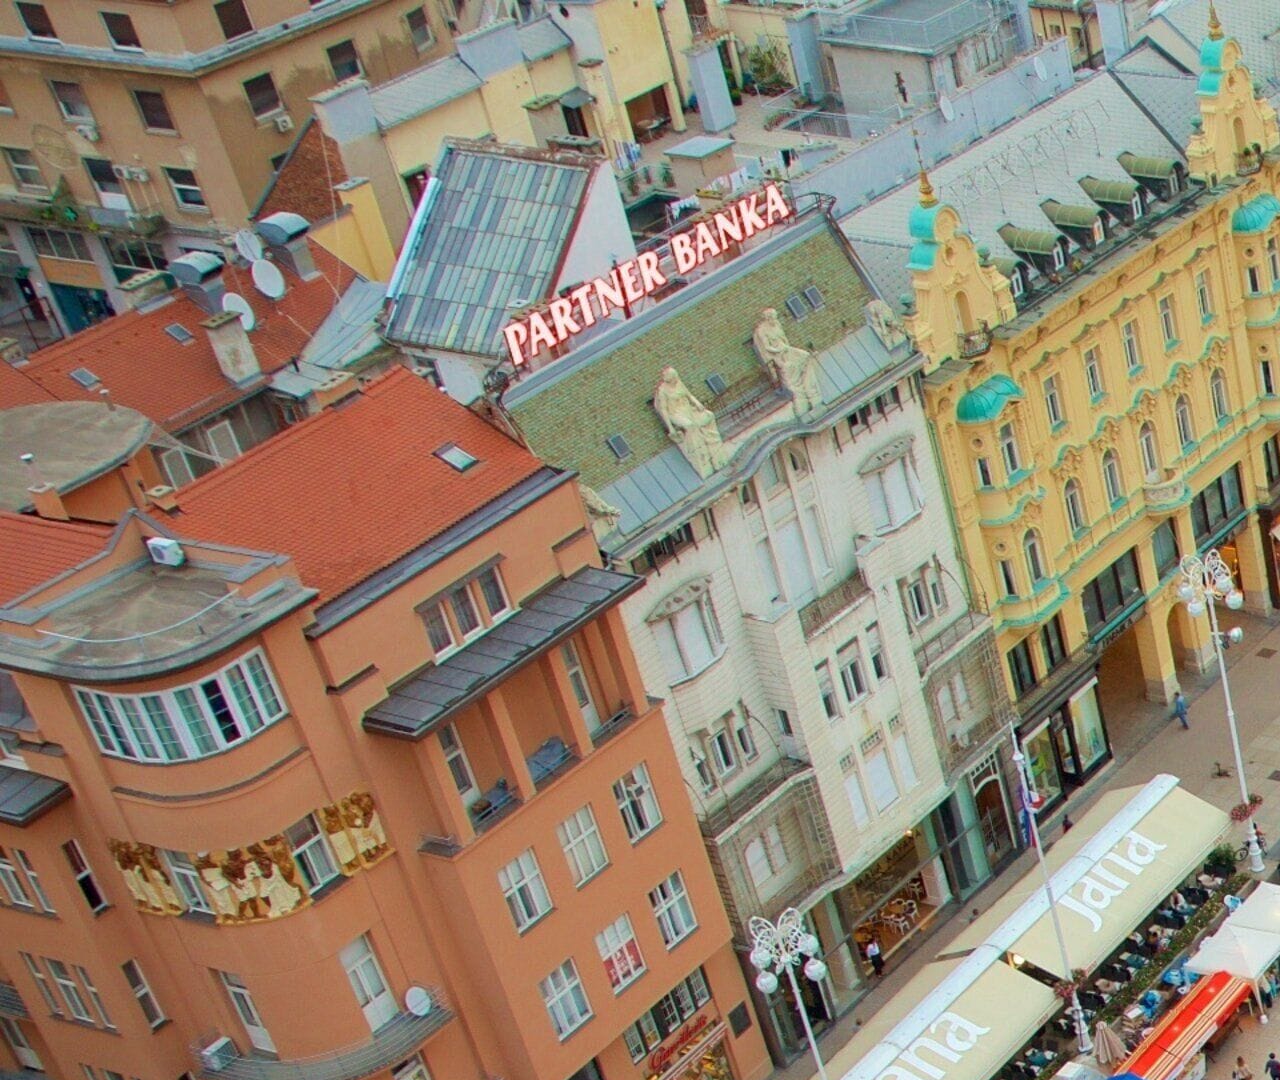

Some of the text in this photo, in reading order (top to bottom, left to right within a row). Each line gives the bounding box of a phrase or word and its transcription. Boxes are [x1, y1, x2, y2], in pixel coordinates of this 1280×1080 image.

[503, 182, 791, 366] PARTNER BANKA
[1059, 831, 1168, 933] Jana
